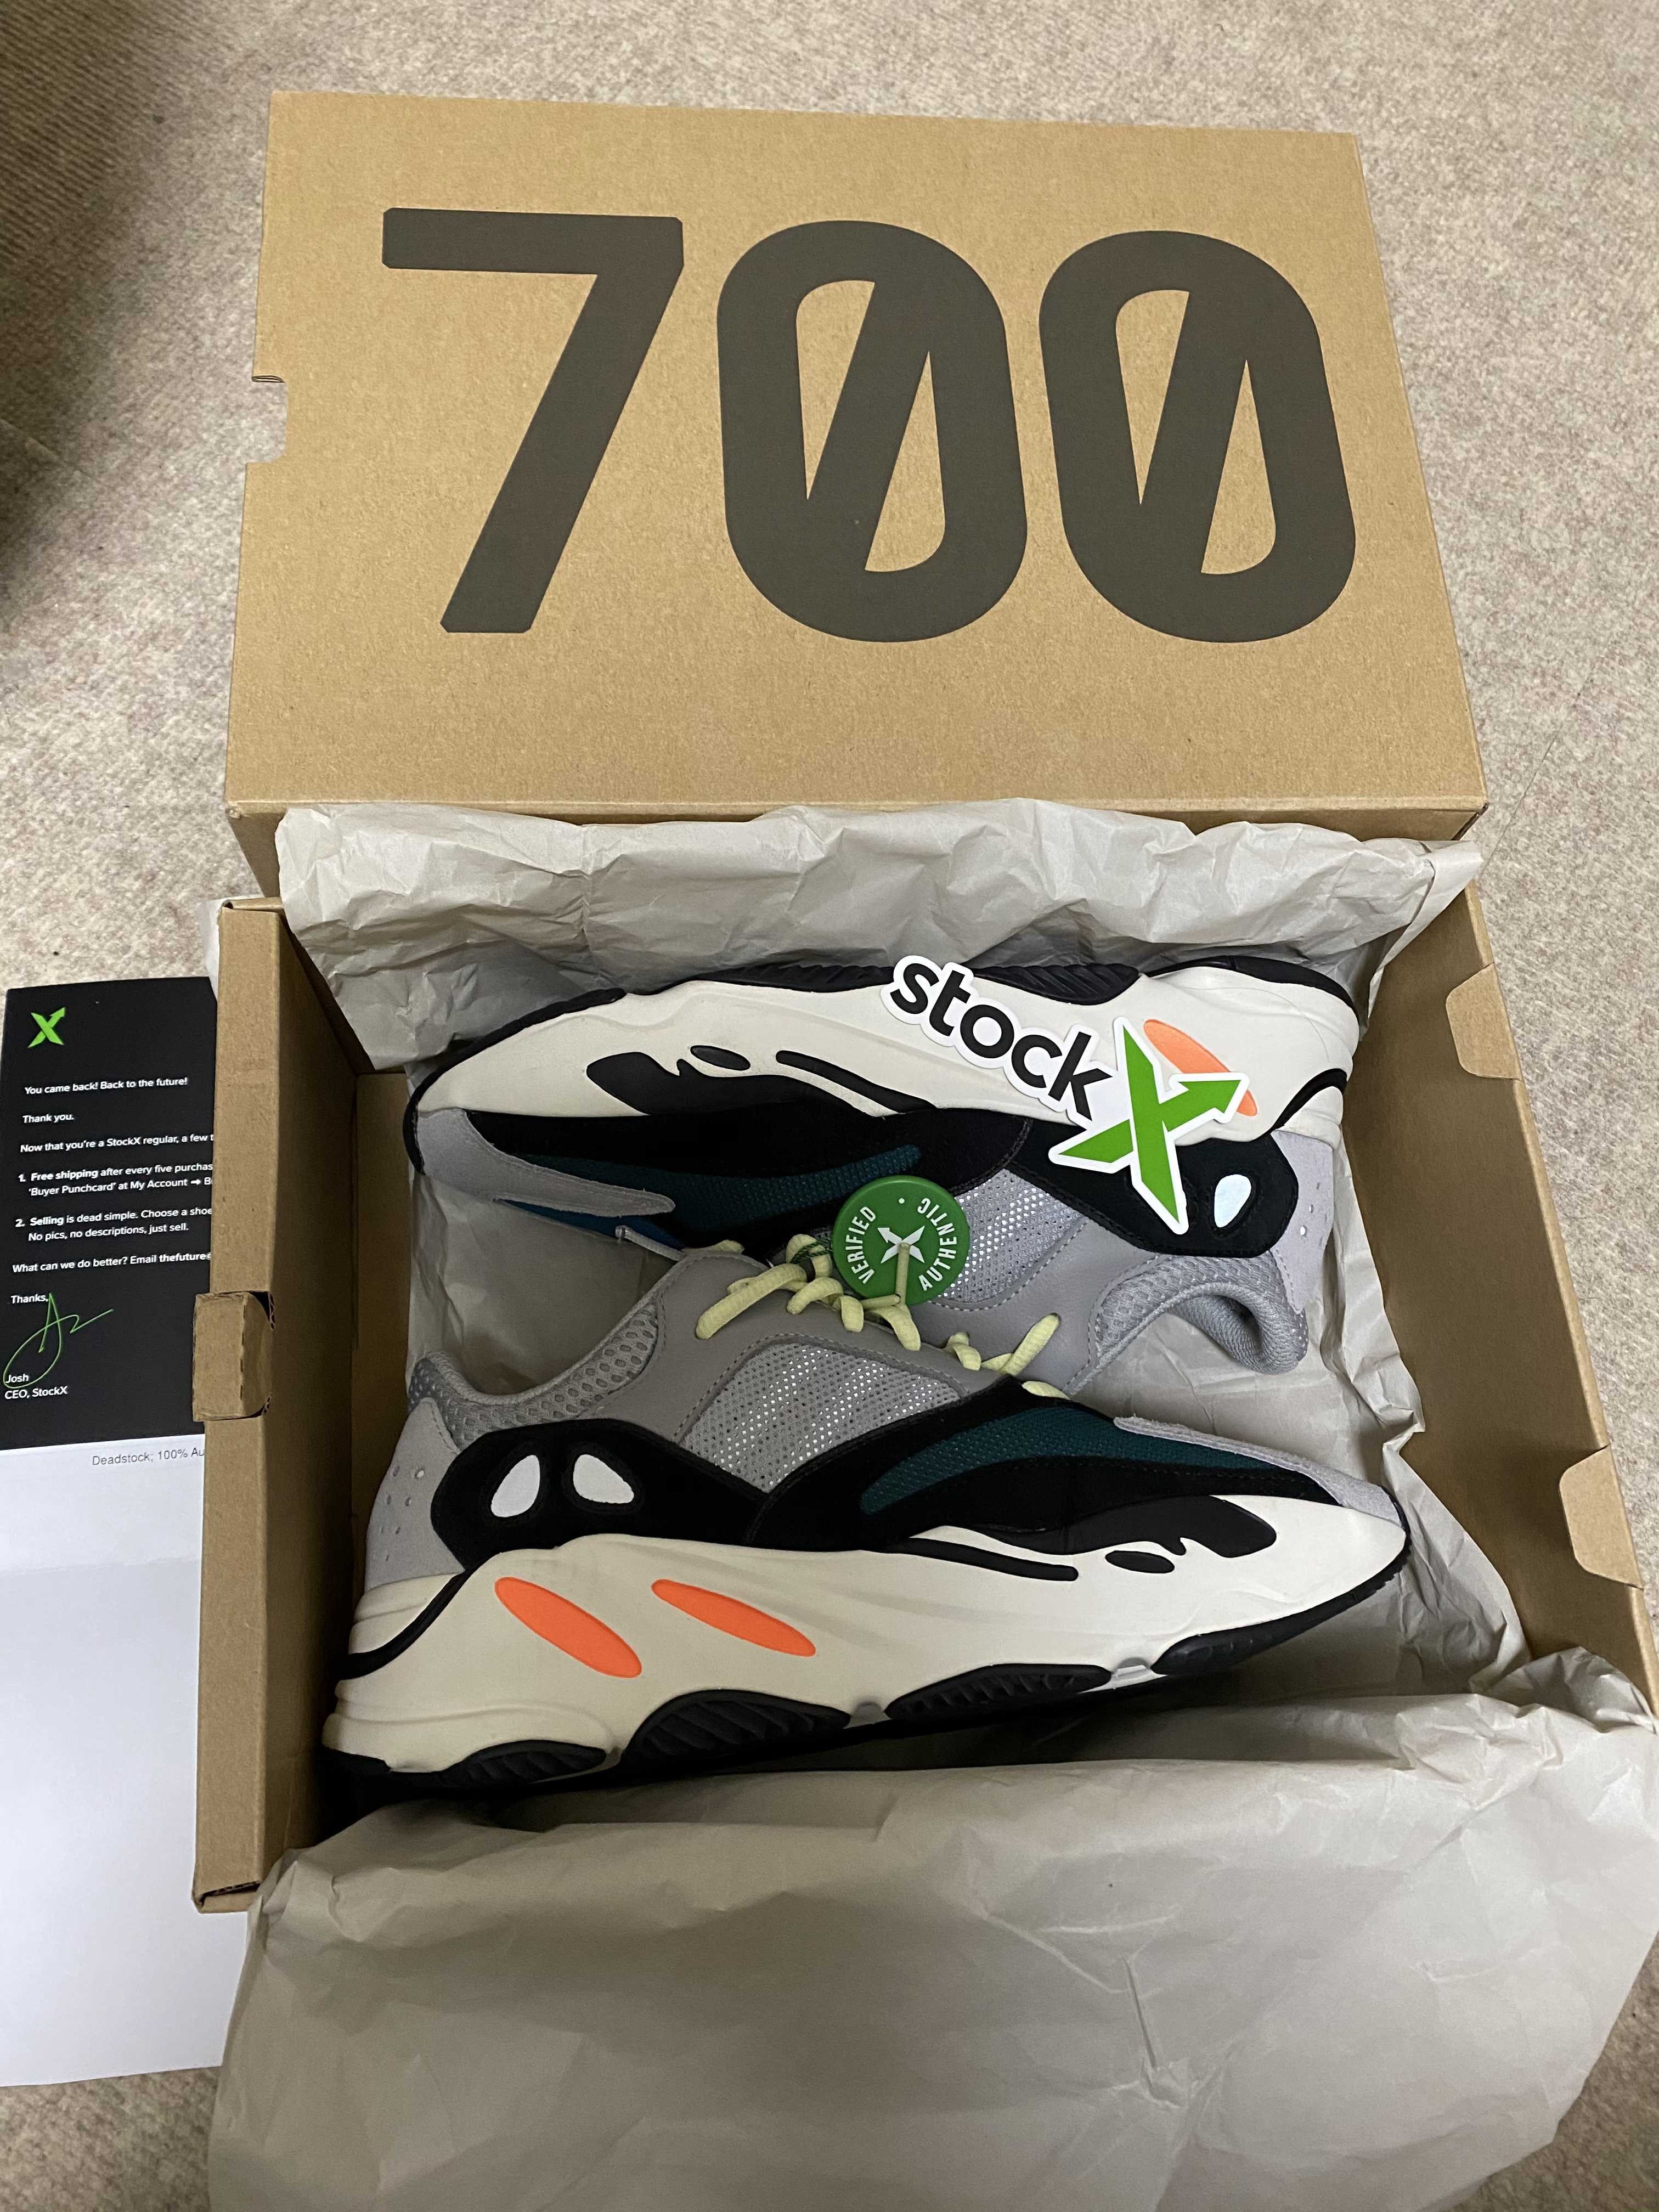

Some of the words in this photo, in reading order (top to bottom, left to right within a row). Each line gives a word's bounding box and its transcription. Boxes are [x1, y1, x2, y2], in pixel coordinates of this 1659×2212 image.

[382, 207, 1356, 643] 700
[73, 1082, 98, 1091] back!
[100, 1081, 123, 1089] Back
[156, 1077, 188, 1086] future!
[22, 1114, 52, 1123] Thank
[54, 1114, 74, 1122] you.
[65, 1141, 96, 1151] you're
[107, 1137, 141, 1146] StockX
[143, 1136, 179, 1146] regular,
[55, 1170, 98, 1180] shipping
[100, 1167, 123, 1176] after
[125, 1167, 153, 1176] every
[131, 1181, 145, 1190] My
[147, 1179, 188, 1188] Account
[204, 1177, 213, 1185] B
[30, 1216, 64, 1226] Selling
[77, 1213, 101, 1222] dead
[104, 1211, 138, 1221] simple.
[29, 1233, 43, 1241] No
[45, 1232, 67, 1242] pics,
[85, 1227, 147, 1237] descriptions,
[148, 1224, 167, 1234] just
[170, 1223, 188, 1231] sell.
[845, 1206, 876, 1284] VERIFIED
[917, 1198, 957, 1291] AUTHENTIC
[13, 1263, 38, 1272] What
[93, 1257, 128, 1266] better?
[130, 1255, 157, 1264] Email
[10, 1294, 48, 1304] Thanks,
[5, 1374, 29, 1384] Josh
[4, 1389, 30, 1400] CEO,
[32, 1386, 67, 1397] StockX
[92, 1453, 153, 1465] Deadstock;
[158, 1448, 188, 1460] 100%
